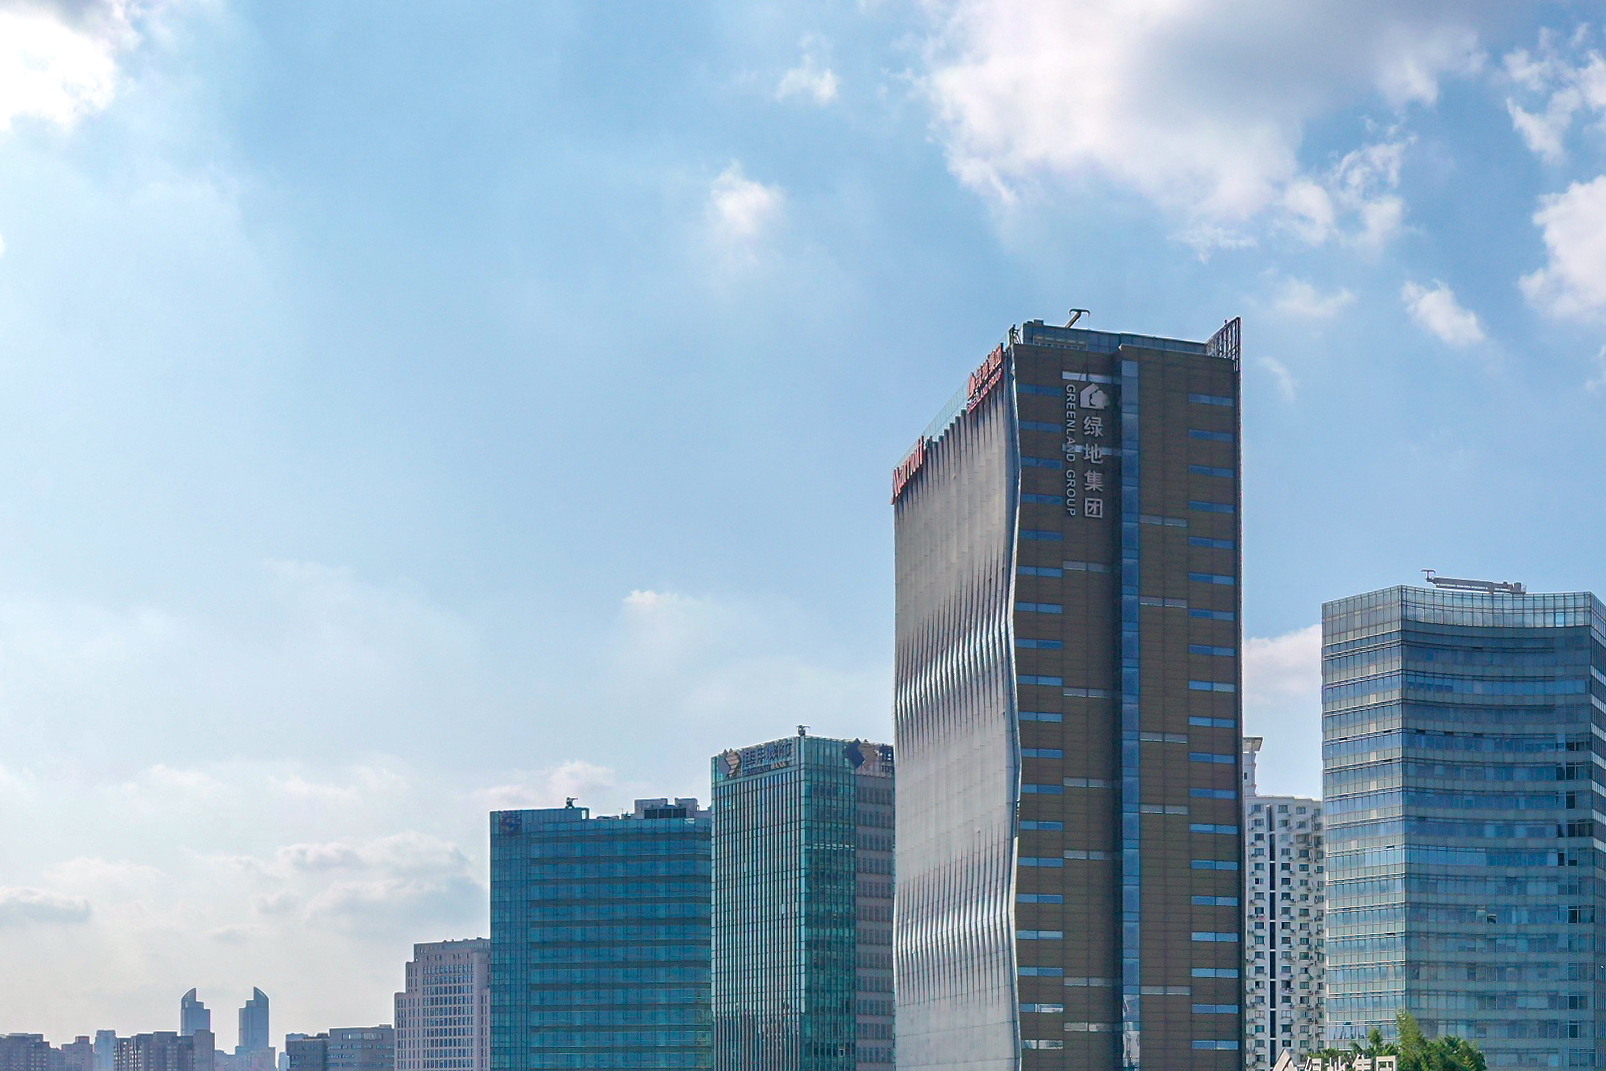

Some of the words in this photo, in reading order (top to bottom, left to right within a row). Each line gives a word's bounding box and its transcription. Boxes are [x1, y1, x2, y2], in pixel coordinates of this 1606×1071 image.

[1066, 384, 1076, 462] GREENLAND
[1066, 469, 1076, 516] GROUP
[1083, 416, 1104, 519] 绿地集团
